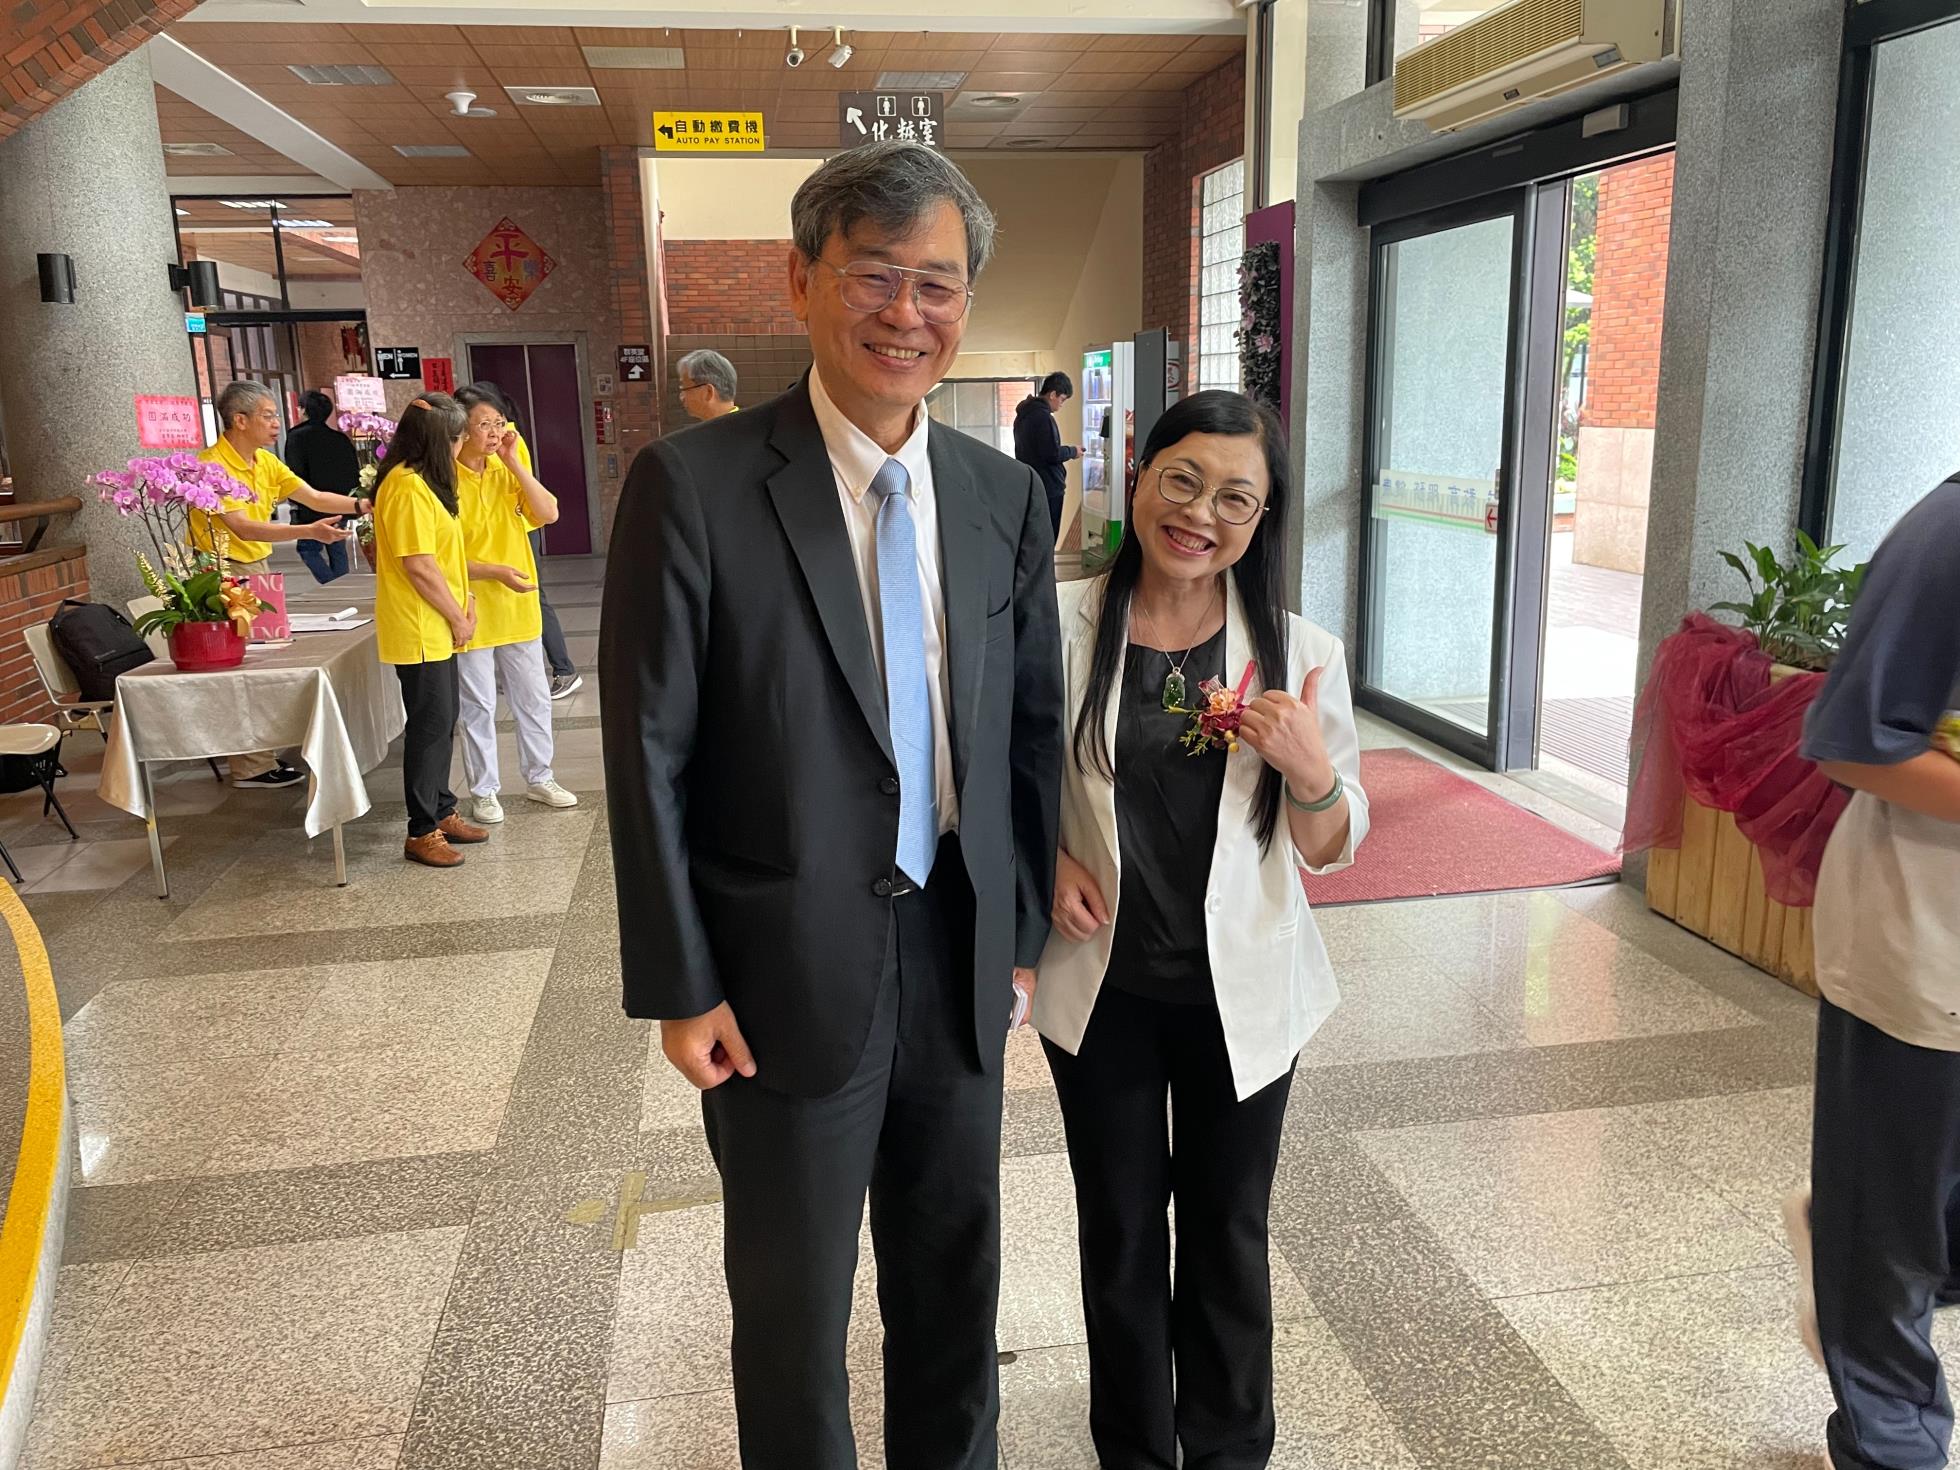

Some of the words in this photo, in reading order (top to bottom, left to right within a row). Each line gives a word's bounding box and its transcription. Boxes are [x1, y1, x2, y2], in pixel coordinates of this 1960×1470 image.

[675, 119, 758, 133] 自動繳費機
[871, 117, 938, 146] 化粧室
[676, 137, 700, 145] AUTO
[704, 137, 720, 145] PAY
[724, 137, 760, 145] STATION
[239, 575, 284, 592] ENG
